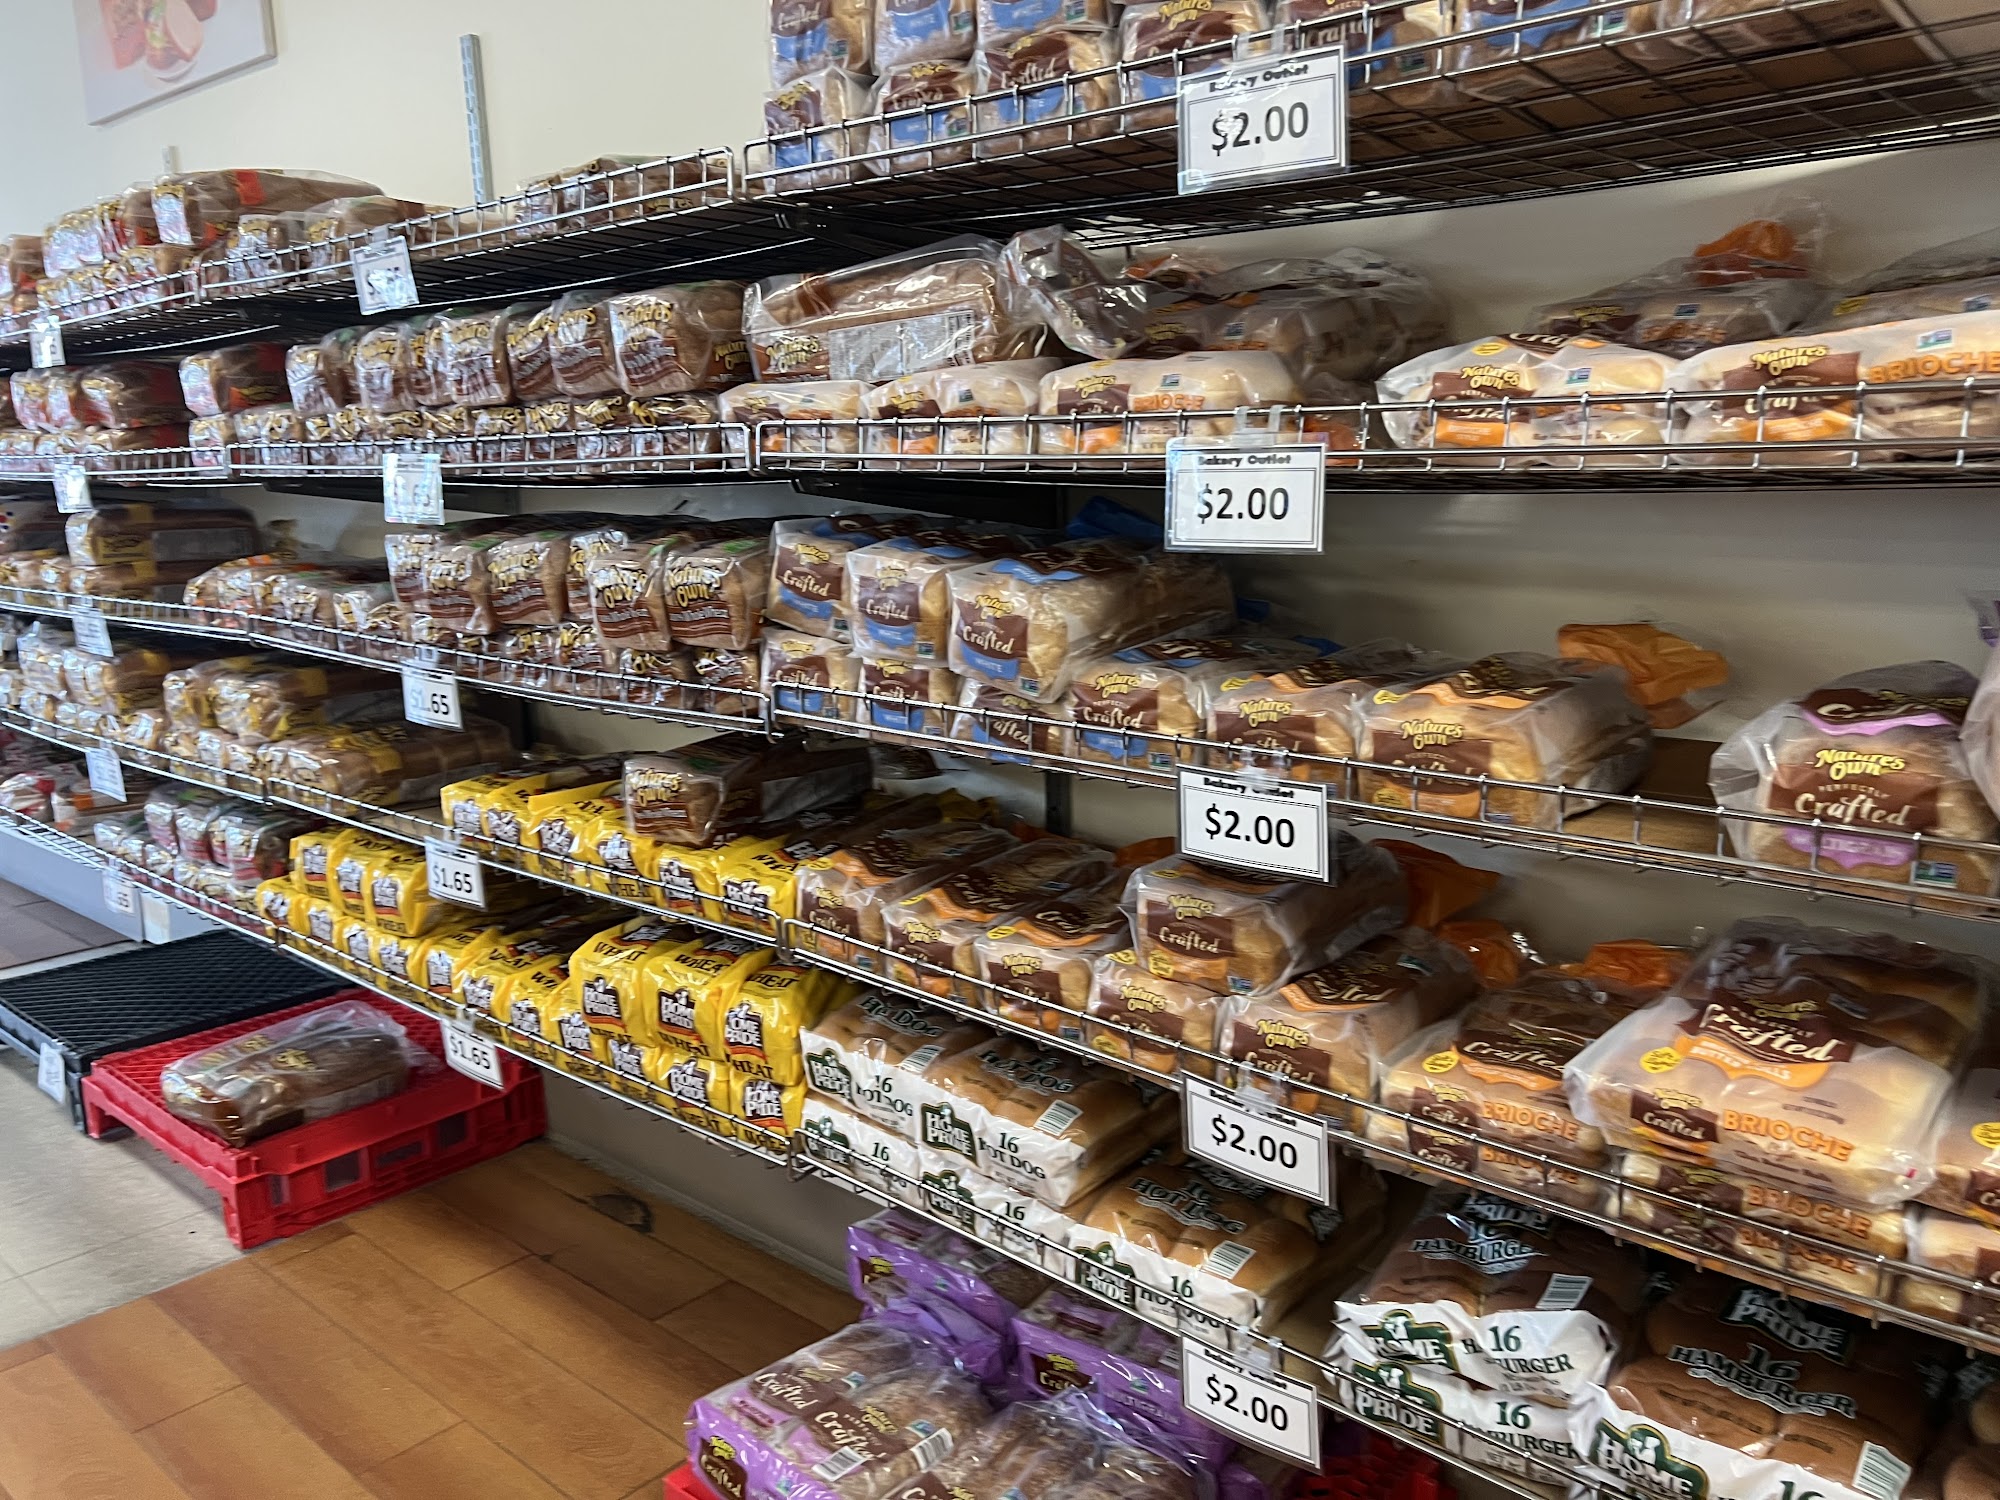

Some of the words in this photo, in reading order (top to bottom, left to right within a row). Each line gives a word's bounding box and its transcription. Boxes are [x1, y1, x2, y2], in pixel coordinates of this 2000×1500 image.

[1211, 101, 1310, 158] $2.00
[1247, 454, 1292, 466] Outlet
[1196, 484, 1290, 524] $2.00
[783, 569, 831, 596] Crafted
[866, 598, 909, 621] Crafted
[962, 627, 1016, 656] Crafted
[1083, 706, 1144, 729] Crafted
[1829, 760, 1882, 781] Own
[1795, 792, 1919, 826] Crafted
[1205, 802, 1295, 849] $2.00
[431, 863, 474, 894] $1.65
[1158, 926, 1219, 954] Crafted
[1699, 1003, 1847, 1062] Crafted
[449, 1034, 491, 1070] $1.65
[925, 1111, 970, 1142] HOME
[1211, 1114, 1298, 1170] $2.00
[1643, 1112, 1706, 1141] Crafted
[1722, 1108, 1856, 1163] BRIOCHE
[871, 1140, 890, 1162] 16
[926, 1127, 974, 1159] PRIDE
[999, 1132, 1019, 1154] 16
[1010, 1154, 1046, 1180] DOG
[1003, 1200, 1025, 1222] 16
[1169, 1274, 1195, 1299] 16
[1489, 1325, 1522, 1353] 16
[1727, 1303, 1846, 1357] PRIDE
[1743, 1341, 1802, 1381] 16
[1667, 1344, 1858, 1420] HAMBURGER
[1205, 1373, 1289, 1433] $2.00
[1355, 1385, 1439, 1437] PRIDE
[1495, 1400, 1533, 1431] 16
[1598, 1429, 1695, 1499] HOME
